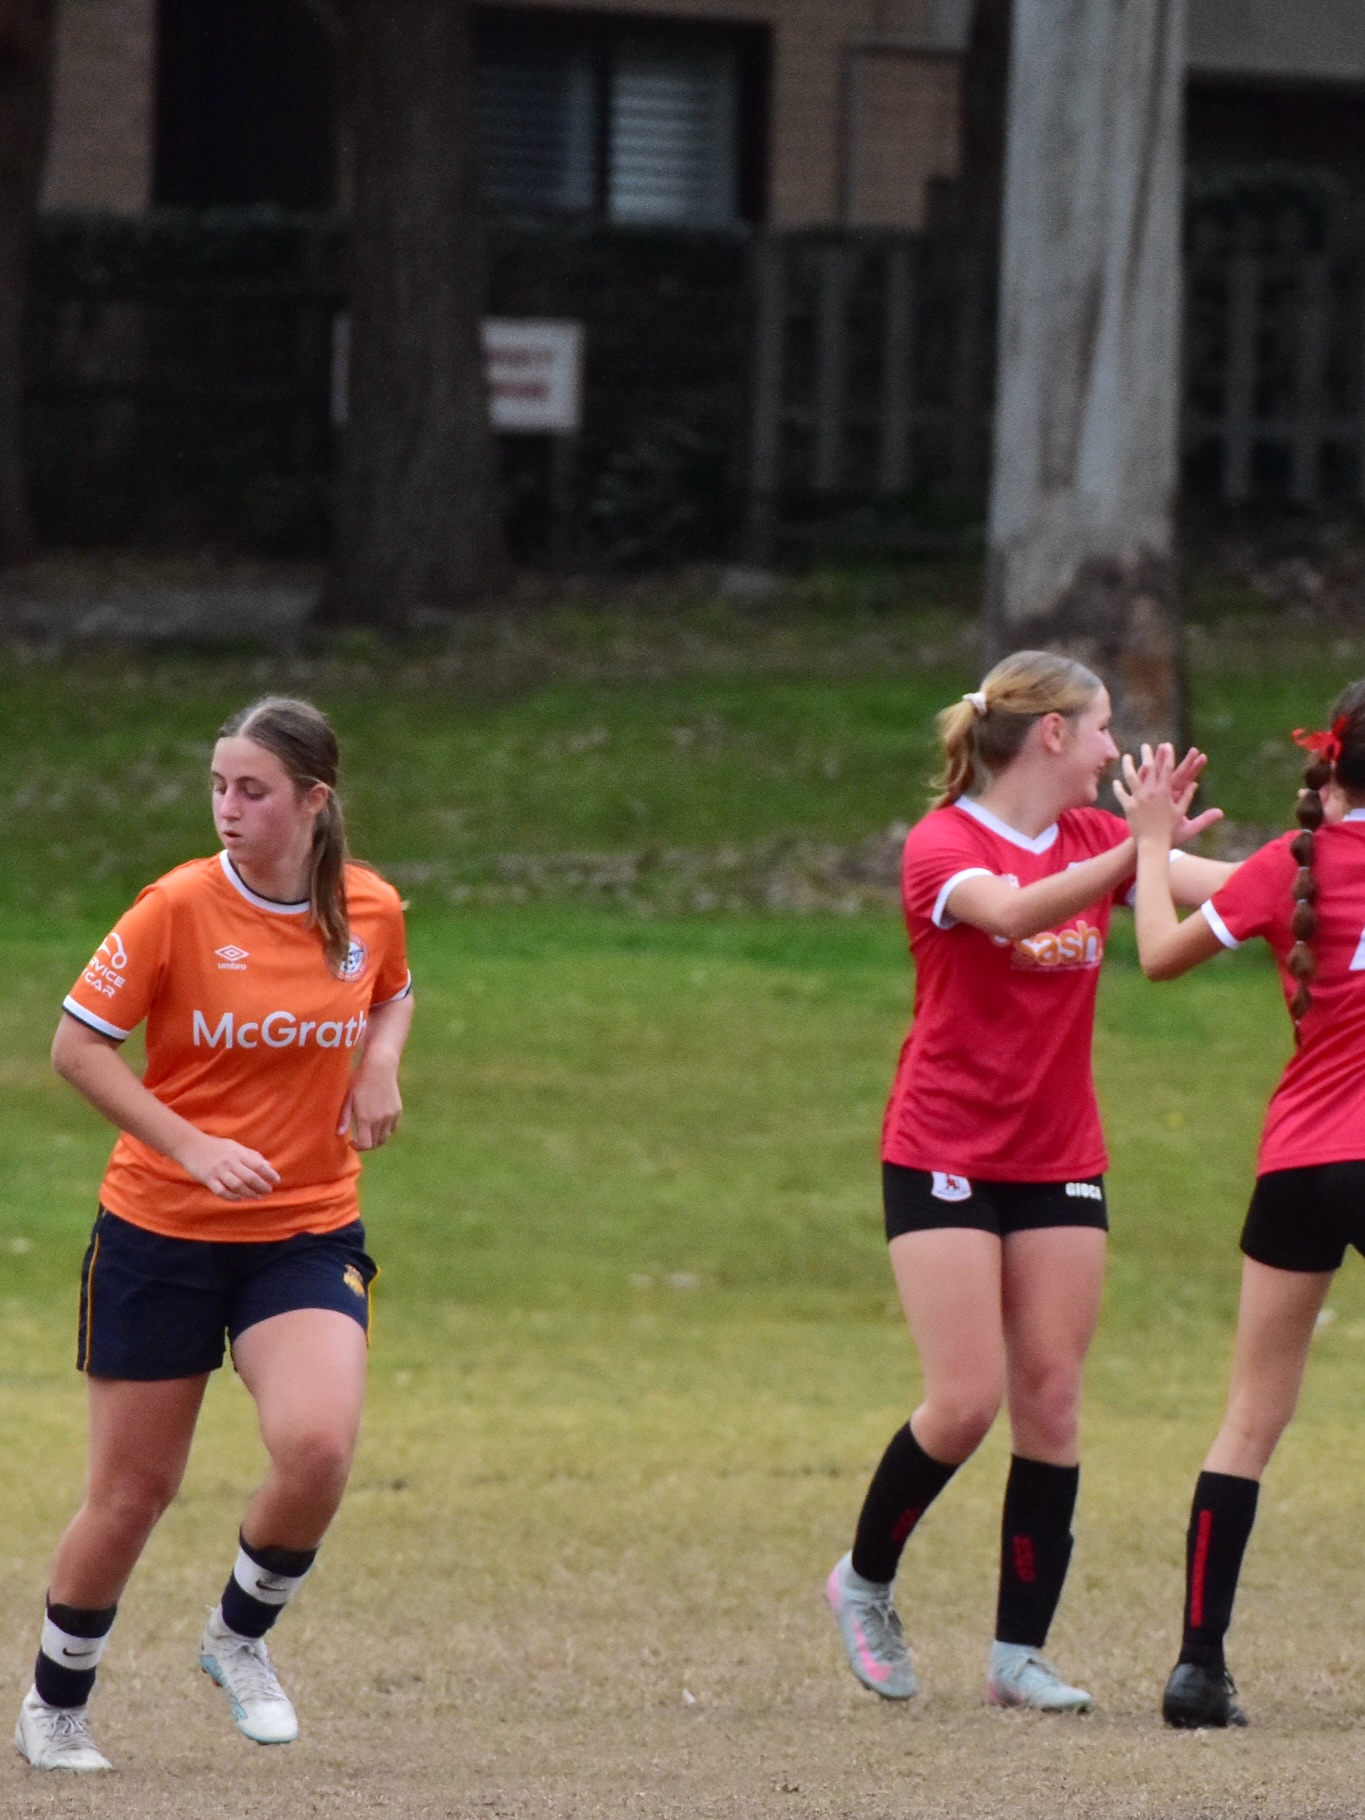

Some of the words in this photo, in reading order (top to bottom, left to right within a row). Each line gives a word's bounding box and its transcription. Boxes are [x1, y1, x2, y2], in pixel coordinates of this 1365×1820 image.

[90, 956, 126, 989] RVICE
[217, 962, 248, 971] umbro
[84, 971, 115, 999] CAR
